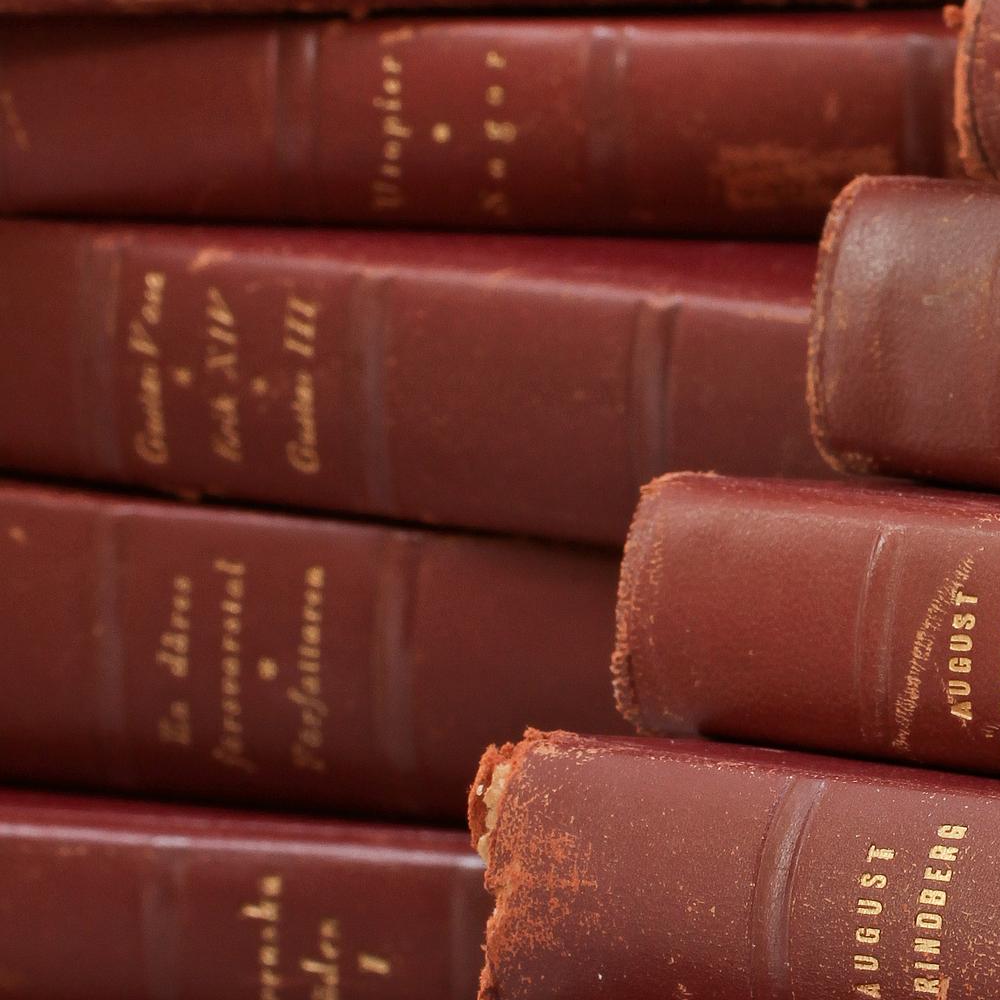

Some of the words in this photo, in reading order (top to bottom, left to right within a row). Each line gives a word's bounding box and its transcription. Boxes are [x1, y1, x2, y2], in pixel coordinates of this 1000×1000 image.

[283, 298, 317, 358] III
[948, 591, 978, 721] AUGUST
[853, 845, 895, 999] AUGUST
